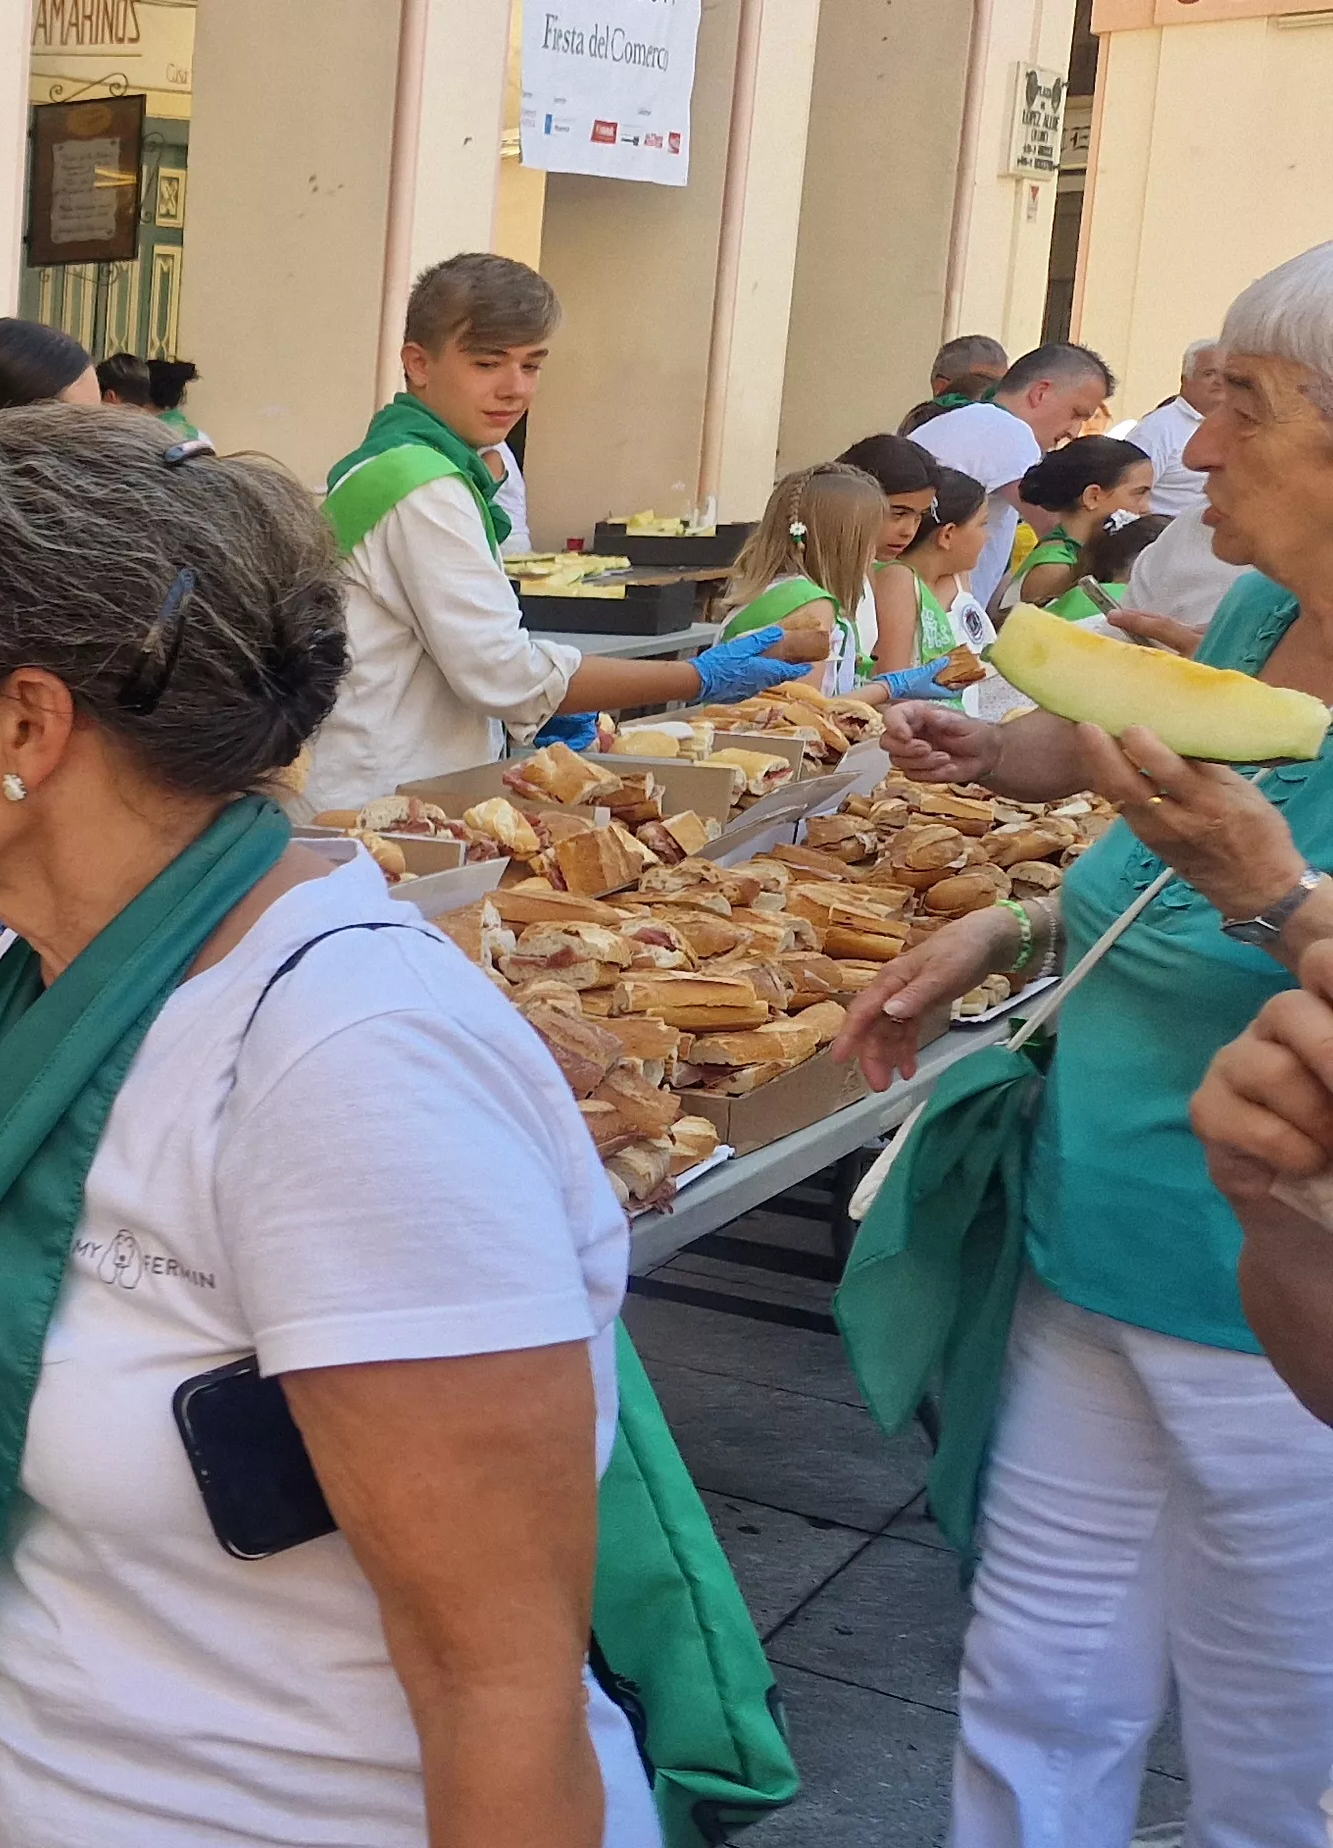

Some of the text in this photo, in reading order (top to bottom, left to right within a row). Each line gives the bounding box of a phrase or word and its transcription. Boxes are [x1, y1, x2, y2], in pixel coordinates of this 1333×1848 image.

[542, 13, 584, 55] Fiesta
[589, 24, 609, 59] del
[73, 1239, 216, 1289] MY FERMIN
